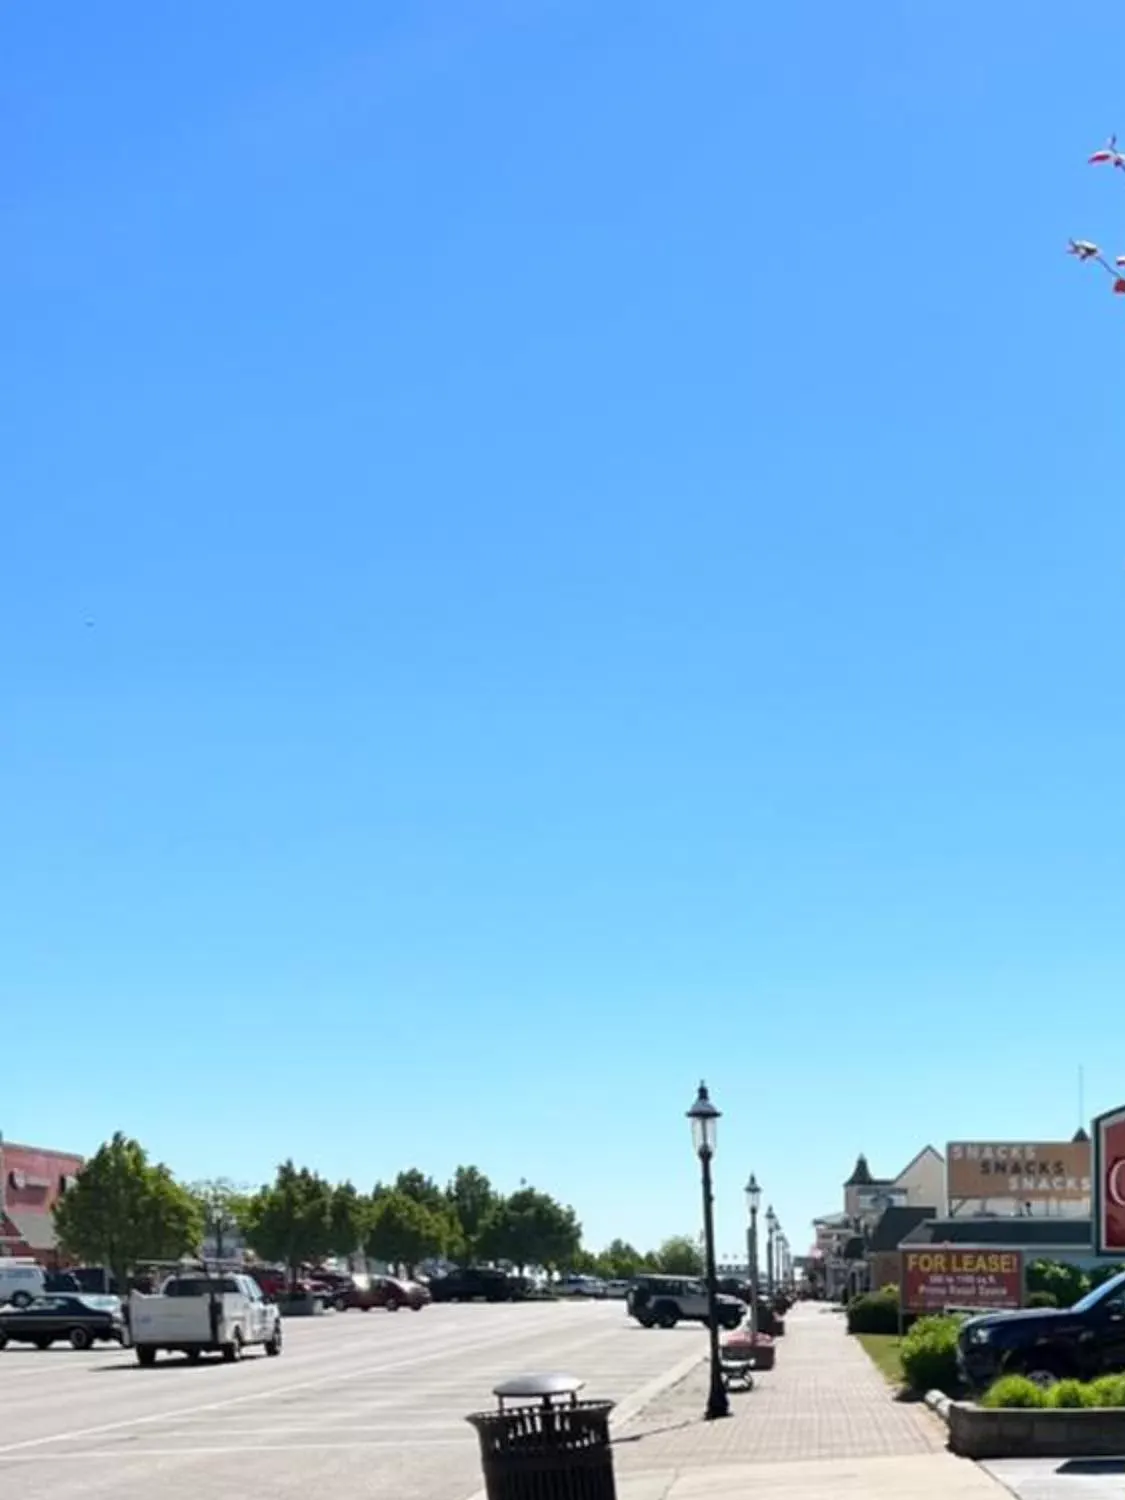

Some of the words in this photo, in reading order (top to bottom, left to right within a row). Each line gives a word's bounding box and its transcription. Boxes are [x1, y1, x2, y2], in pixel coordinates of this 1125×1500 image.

[952, 1144, 1036, 1160] SNACKS
[981, 1160, 1064, 1175] SNACKS
[1009, 1176, 1091, 1192] SNACKS
[907, 1254, 945, 1272] FOR
[951, 1254, 1018, 1272] LEASE!
